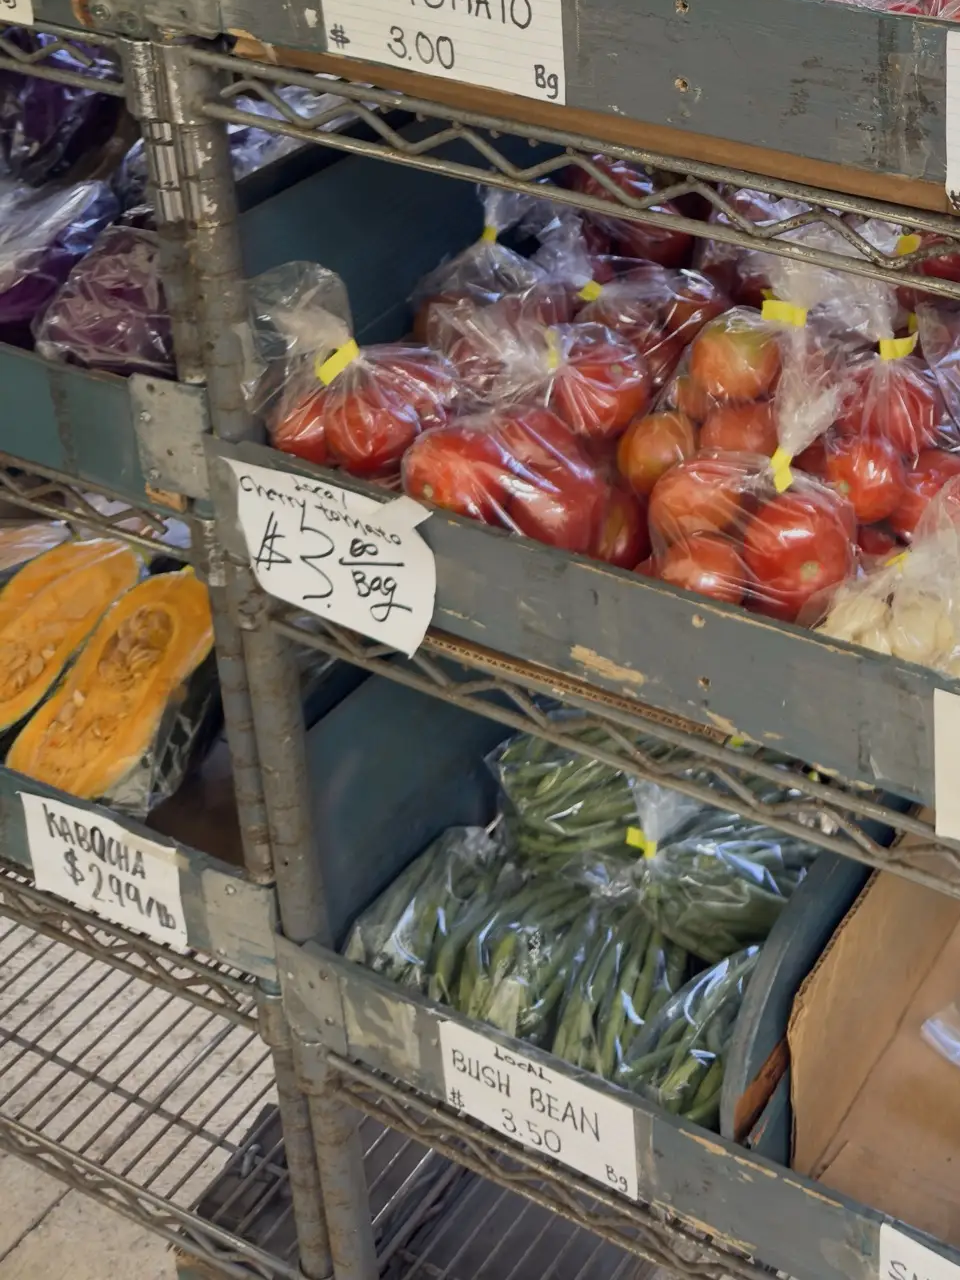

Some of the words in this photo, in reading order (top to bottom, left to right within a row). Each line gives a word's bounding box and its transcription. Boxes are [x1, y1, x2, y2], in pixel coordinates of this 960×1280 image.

[386, 25, 455, 70] 3.00
[533, 64, 559, 100] Bg
[351, 569, 413, 623] Bag
[451, 1048, 511, 1098] BUSH
[530, 1086, 600, 1142] BEAN
[501, 1107, 561, 1154] 3.50
[605, 1163, 628, 1193] Bg
